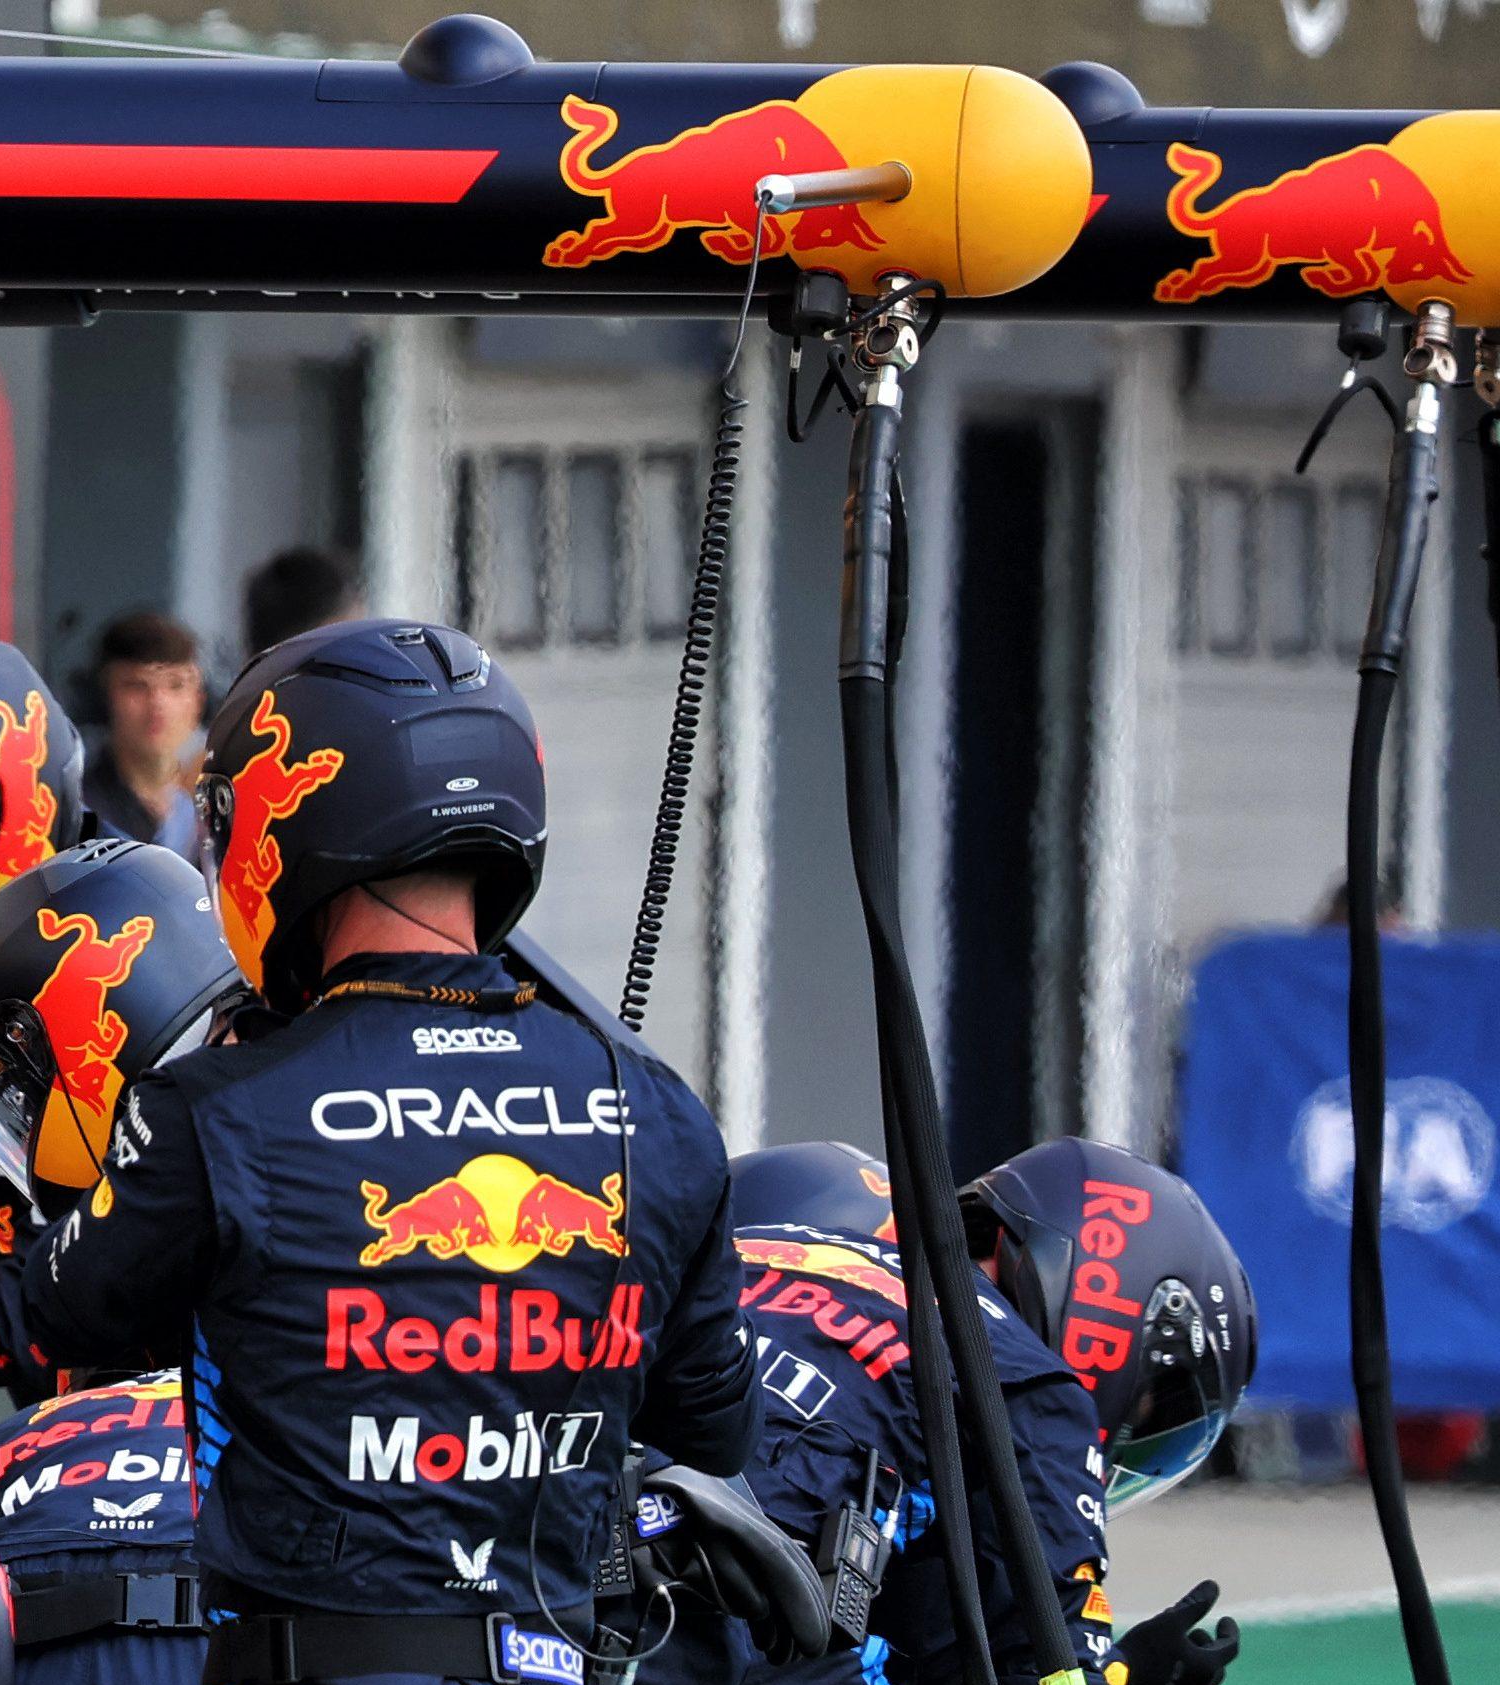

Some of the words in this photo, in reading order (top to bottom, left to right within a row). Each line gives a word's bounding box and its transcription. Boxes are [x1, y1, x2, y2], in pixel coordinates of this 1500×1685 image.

[432, 802, 495, 817] R.WOLVERSON
[412, 1027, 520, 1055] sparco
[311, 1086, 636, 1141] ORACLE
[1073, 1180, 1150, 1317] Red
[325, 1284, 498, 1373] Red
[510, 1283, 646, 1373] Bull
[756, 1281, 910, 1381] Bull
[784, 1360, 818, 1401] 1
[349, 1410, 543, 1483] Mobil
[90, 1520, 155, 1530] CASTORE
[443, 1579, 498, 1591] CASTORE
